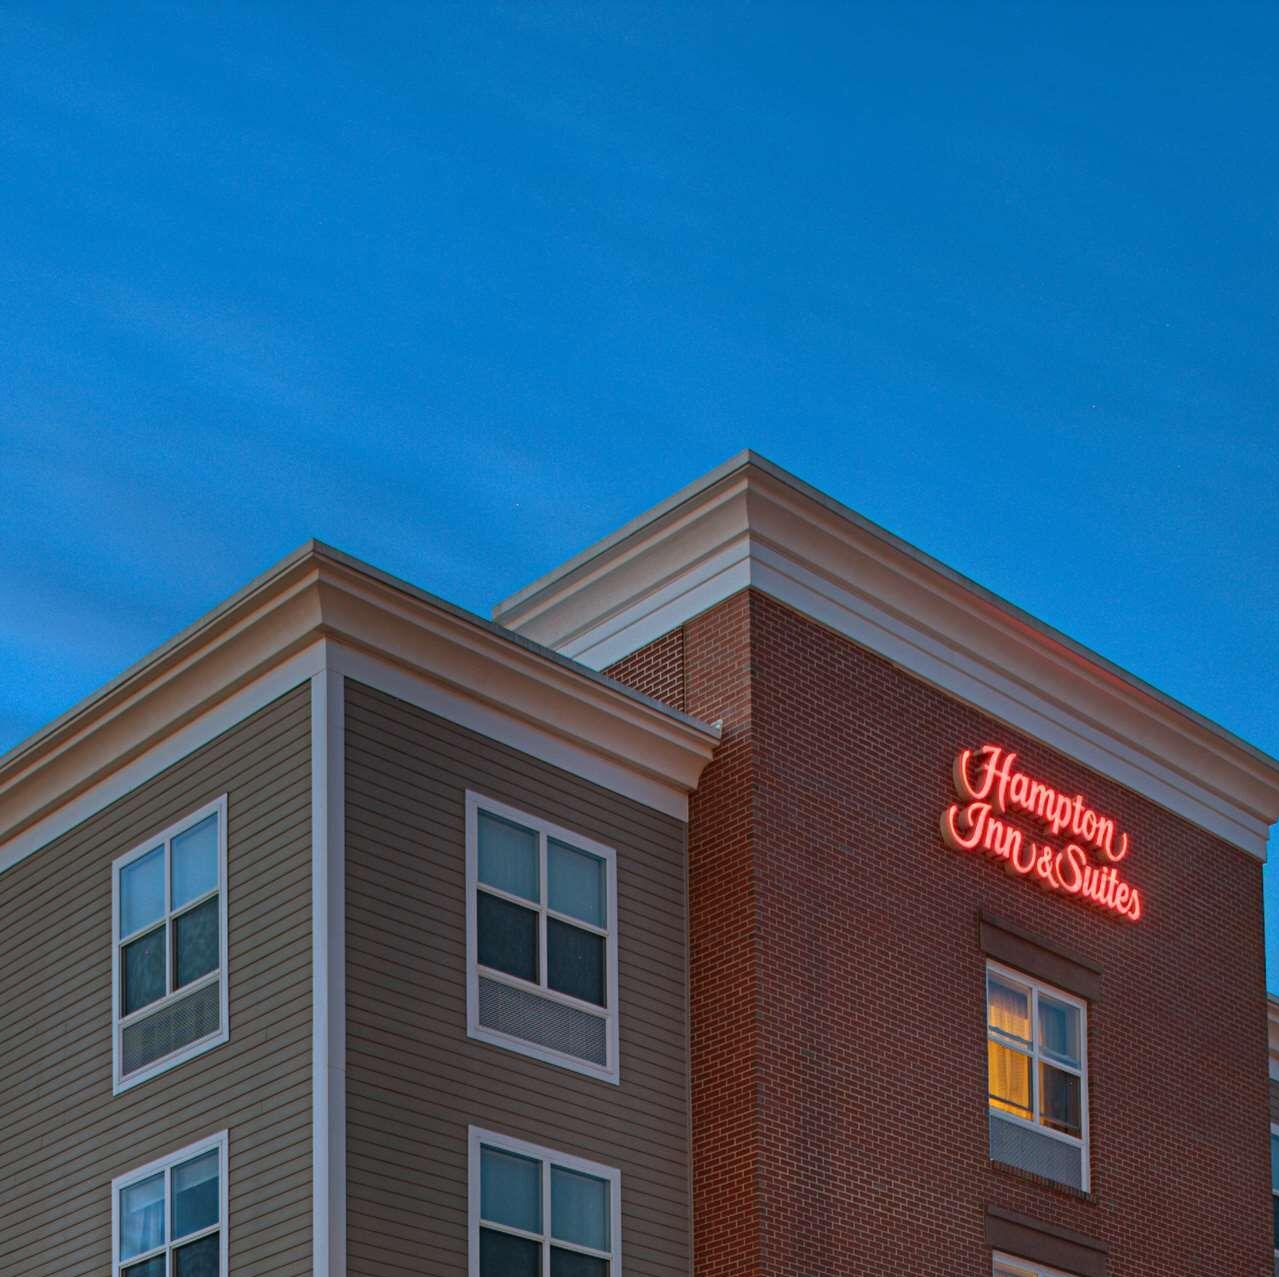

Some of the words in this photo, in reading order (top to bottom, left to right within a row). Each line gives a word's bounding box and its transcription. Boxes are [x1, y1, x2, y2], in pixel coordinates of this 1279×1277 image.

[948, 802, 1036, 874] Inn
[1036, 847, 1060, 888] &
[1055, 844, 1142, 921] Suites
[961, 745, 1129, 862] Hampton
